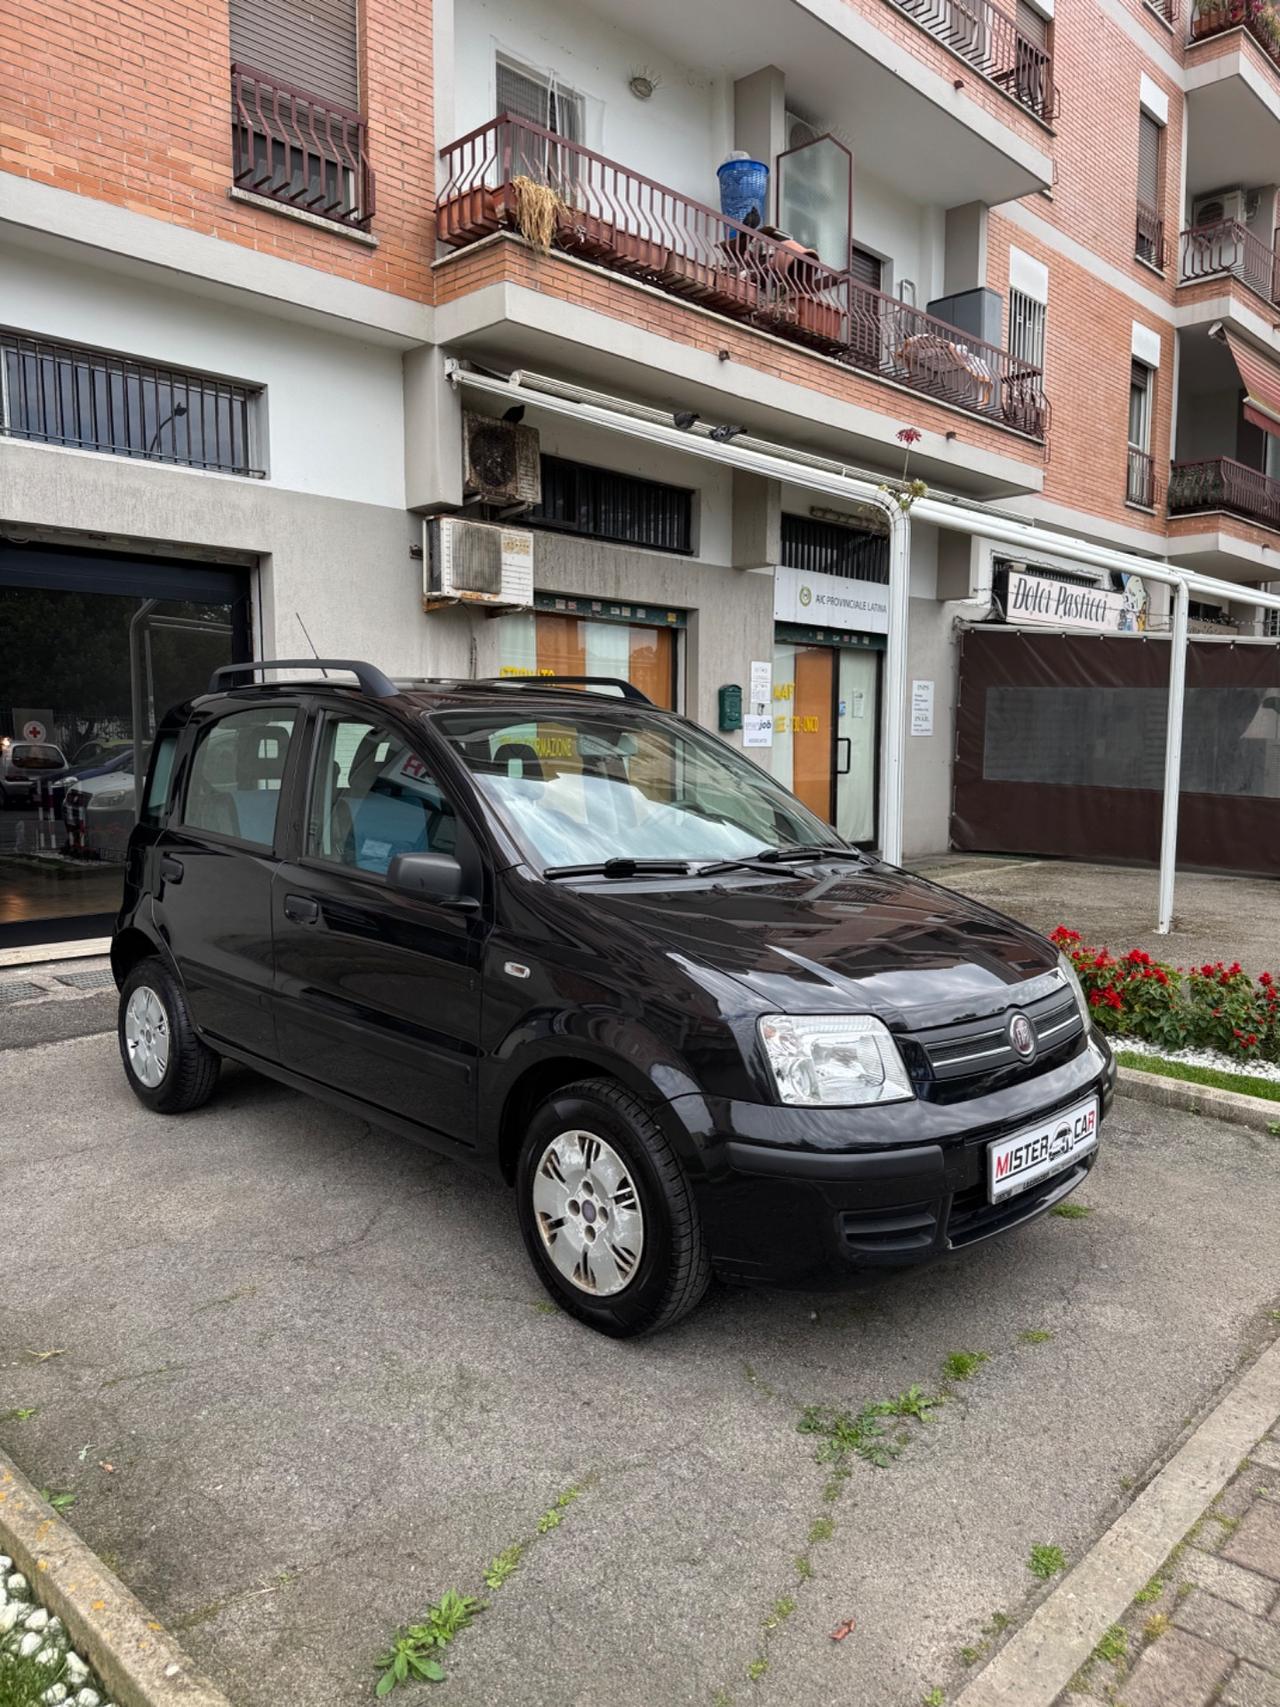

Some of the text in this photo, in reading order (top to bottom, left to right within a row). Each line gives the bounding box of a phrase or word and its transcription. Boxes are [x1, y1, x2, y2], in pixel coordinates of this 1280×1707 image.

[827, 595, 867, 611] PROVINCIALE
[868, 601, 888, 614] LATINA
[1012, 577, 1107, 623] Dolci Pasticci
[996, 1135, 1049, 1179] MISTER
[1074, 1110, 1096, 1139] CAR
